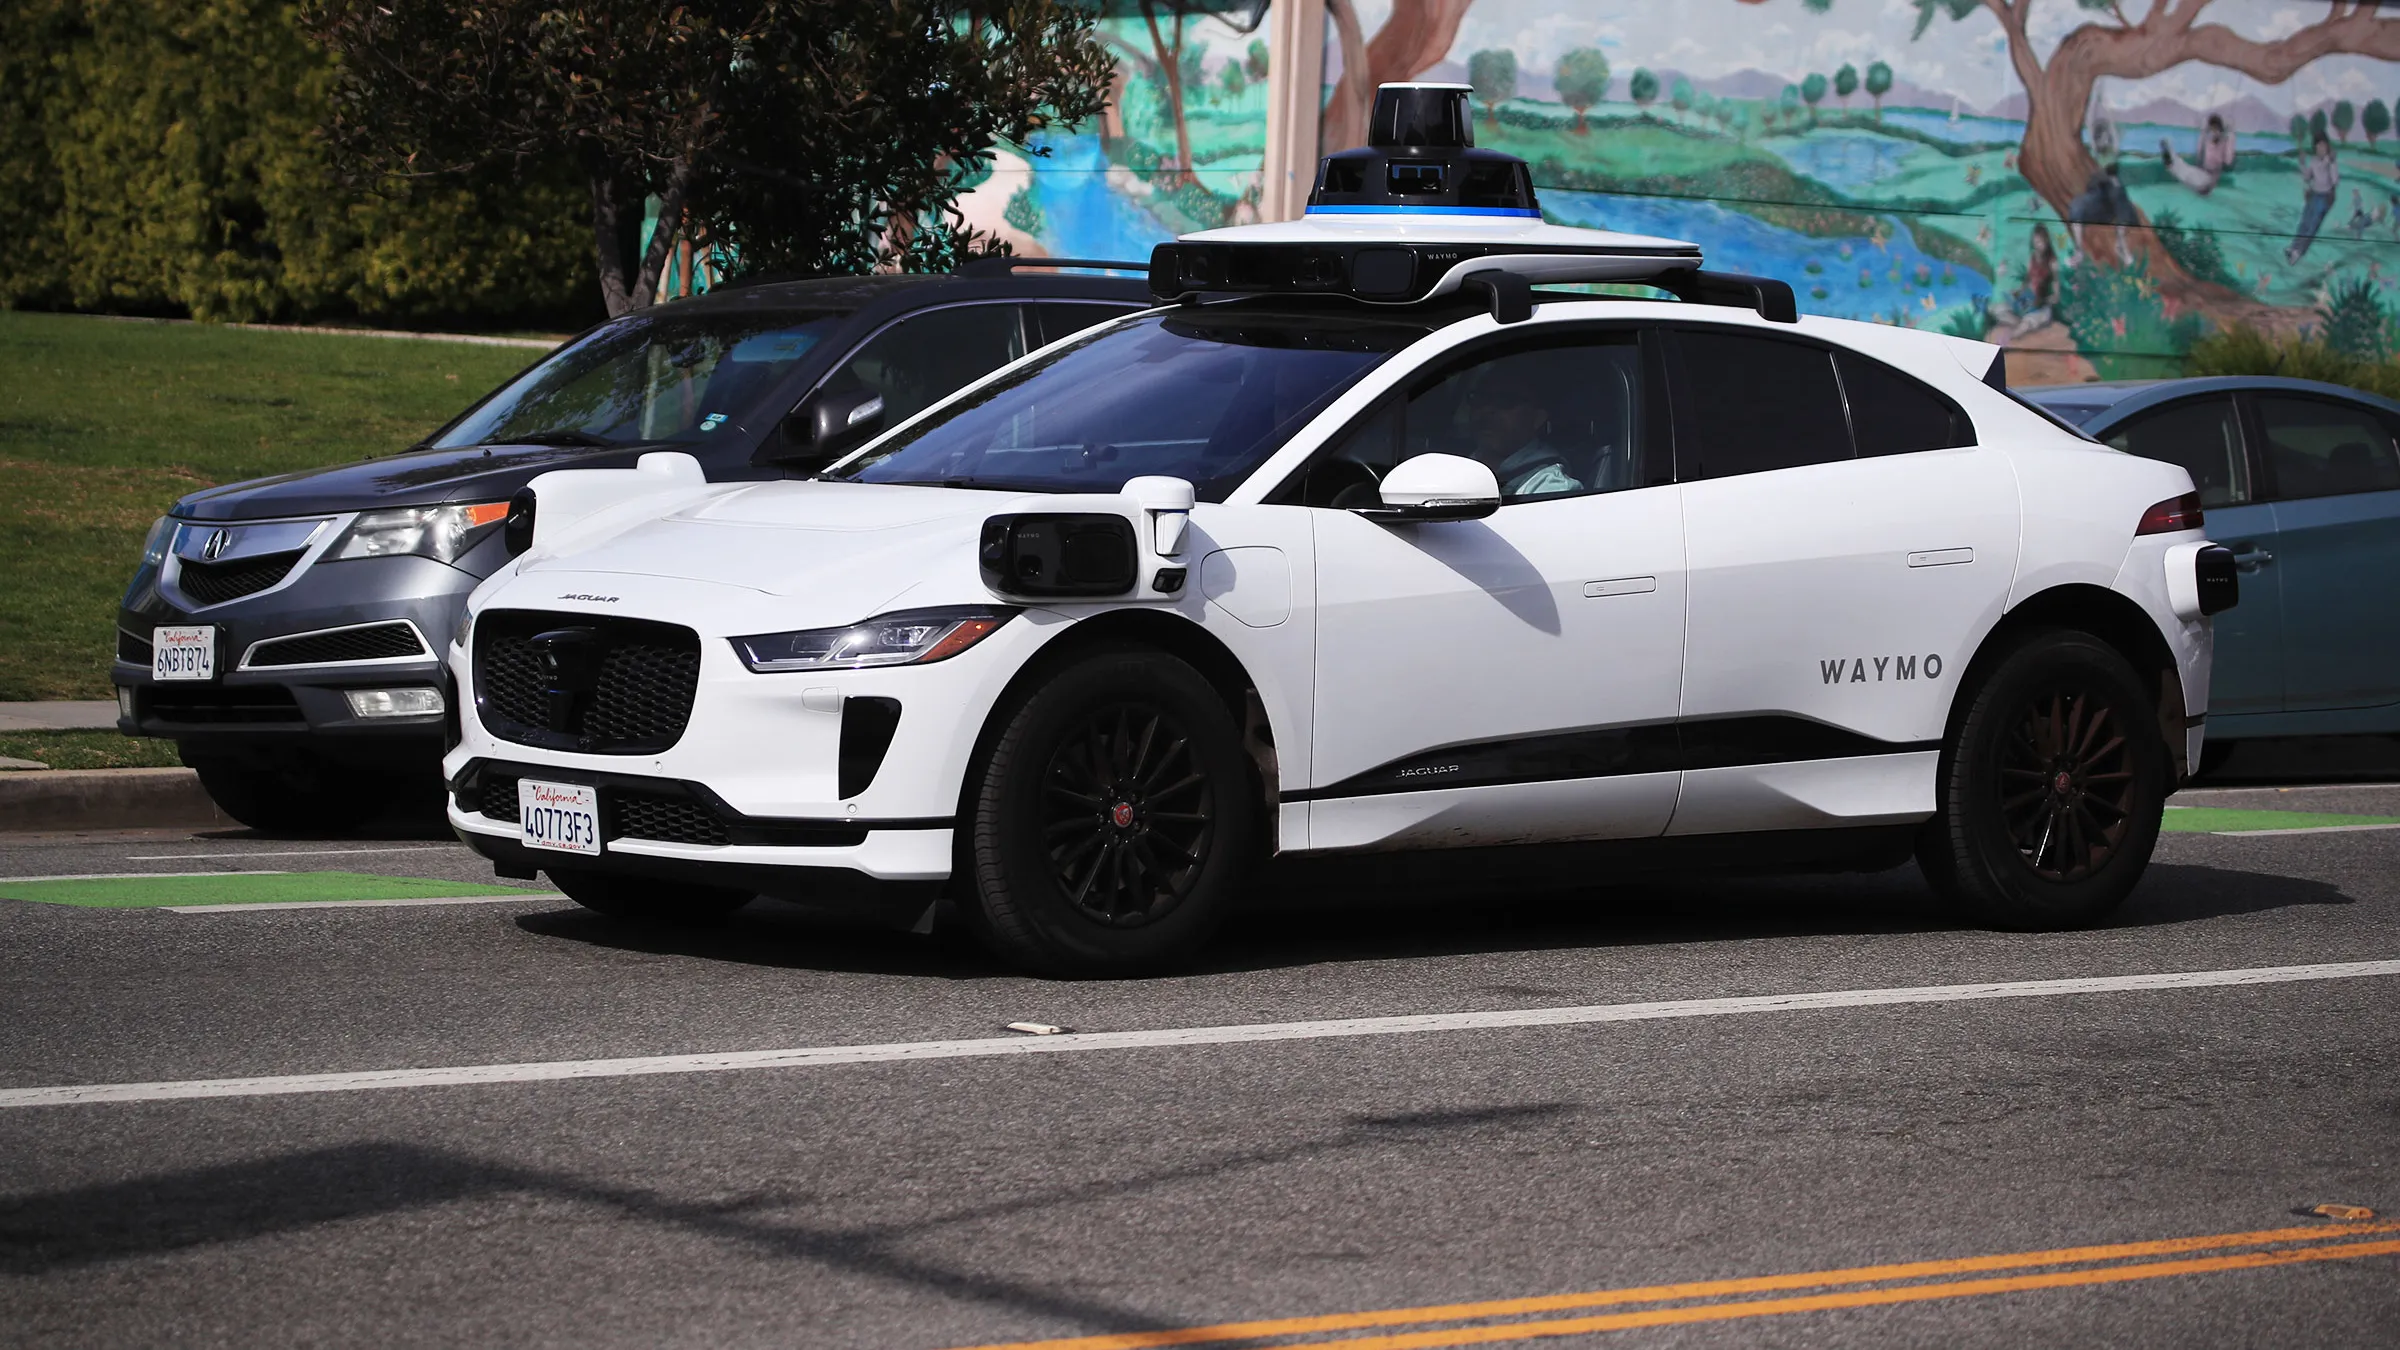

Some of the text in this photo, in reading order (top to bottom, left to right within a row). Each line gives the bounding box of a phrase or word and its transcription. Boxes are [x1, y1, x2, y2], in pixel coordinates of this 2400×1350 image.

[1427, 252, 1458, 260] WAYMO
[557, 594, 620, 603] JAGUAR
[165, 631, 202, 646] California
[157, 647, 210, 672] 6NBT874
[1820, 653, 1943, 685] WAYMO
[1395, 764, 1459, 778] JAGUAR
[535, 785, 583, 807] California
[525, 806, 593, 845] 40773F3
[541, 840, 582, 850] dmv.ca.gov
